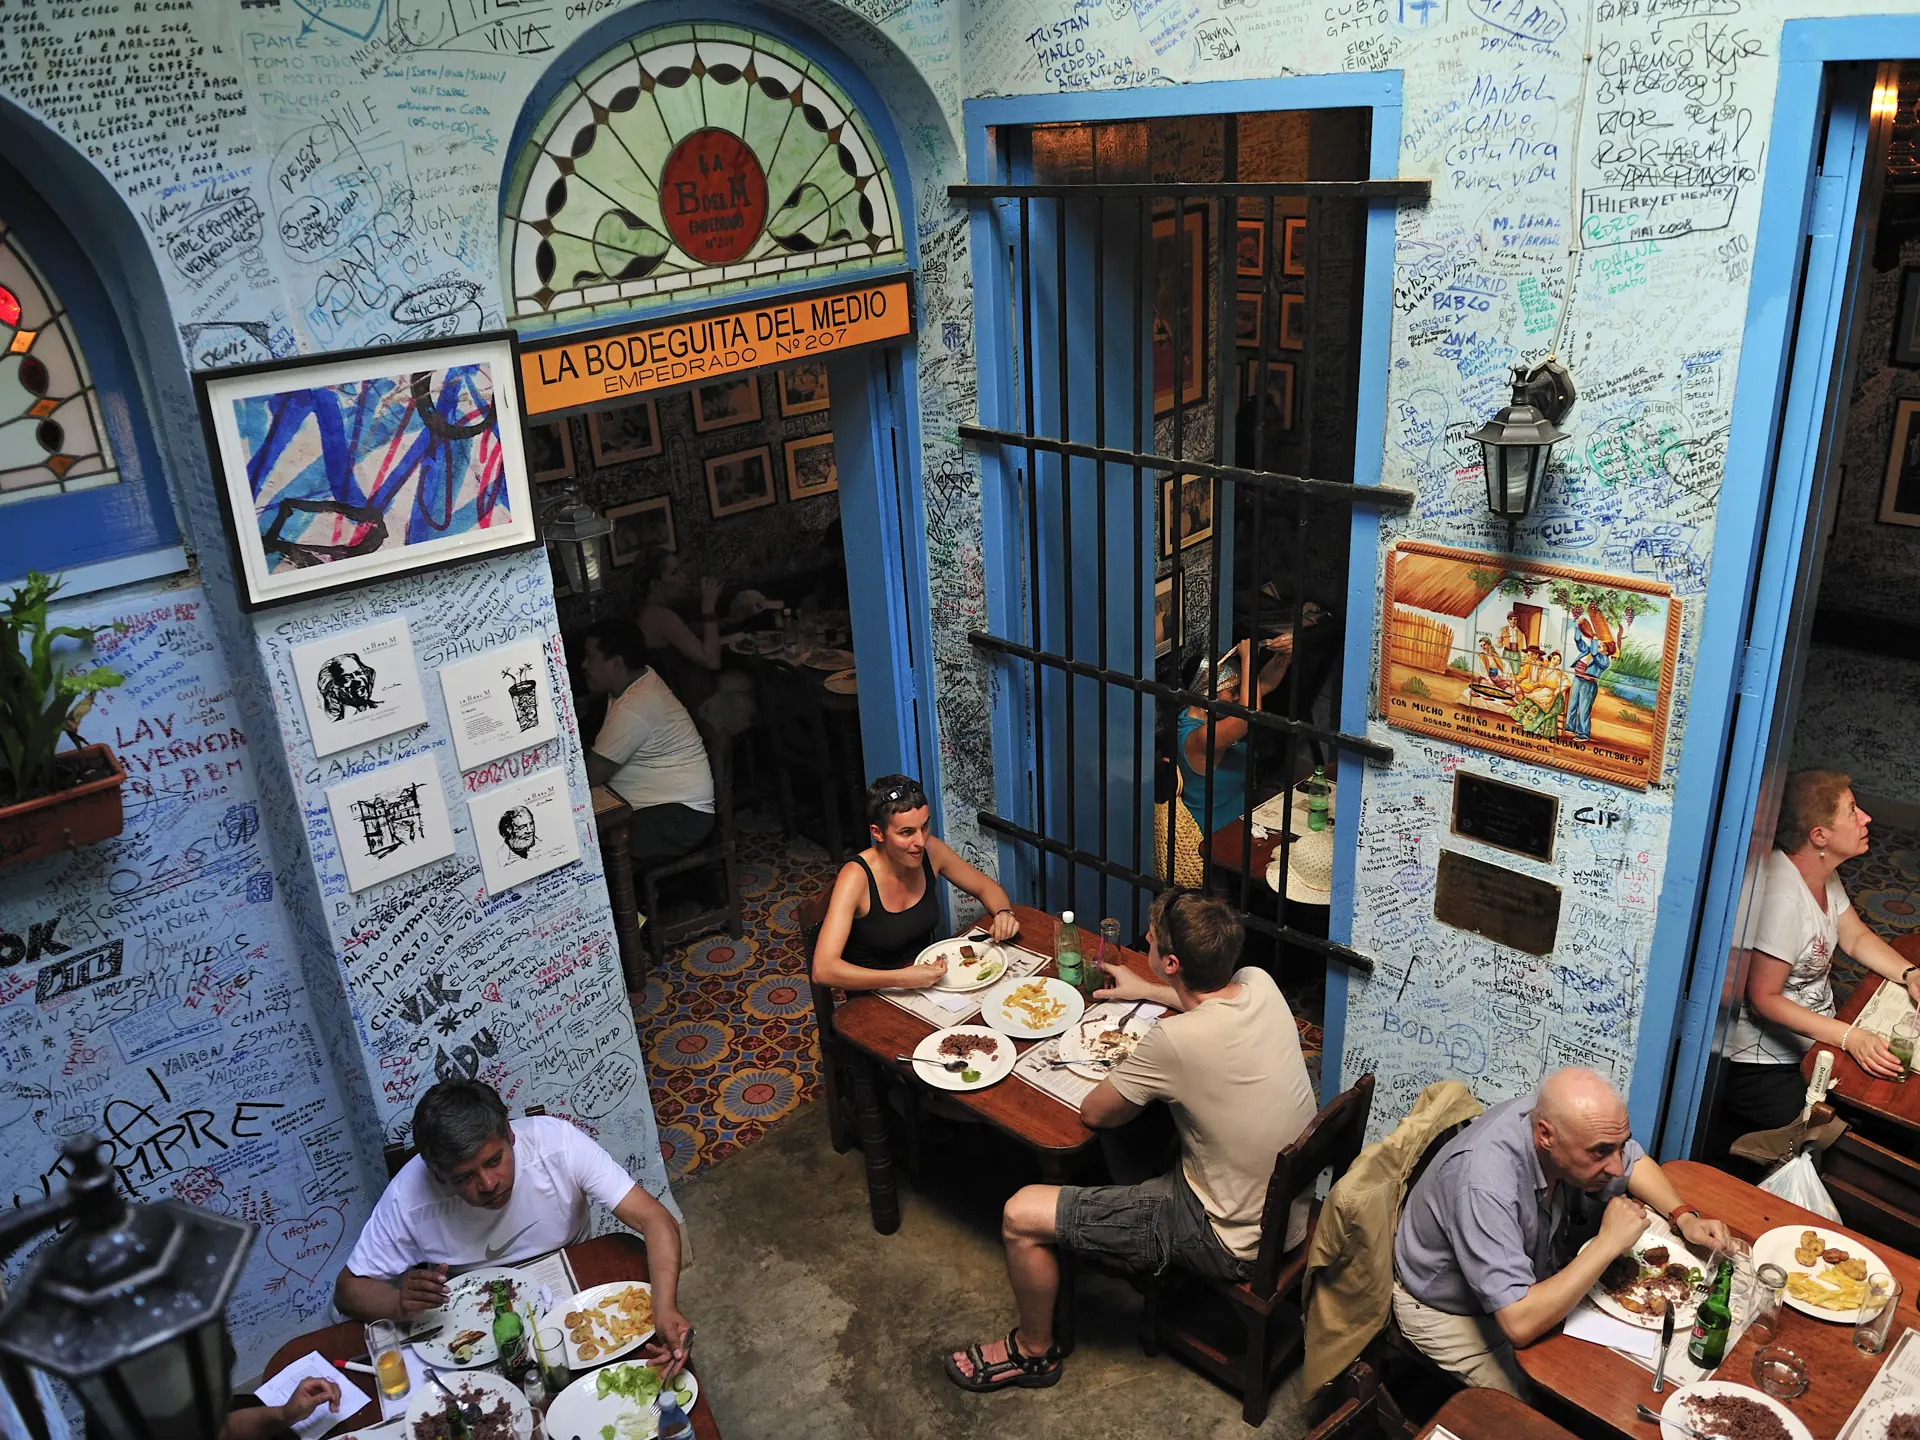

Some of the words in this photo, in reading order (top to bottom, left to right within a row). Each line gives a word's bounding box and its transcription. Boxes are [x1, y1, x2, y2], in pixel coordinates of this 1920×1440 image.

[52, 8, 75, 20] DEL
[82, 5, 120, 17] CIELO
[155, 1, 194, 12] CALAR
[1326, 10, 1389, 37] GATTO
[22, 35, 63, 49] BASSO
[126, 24, 150, 35] DEL
[44, 45, 83, 58] PESCE
[1037, 38, 1085, 68] MARCO
[115, 99, 137, 110] PER
[99, 114, 138, 127] LUNGO
[165, 116, 187, 128] CHE
[698, 153, 724, 175] LA
[128, 177, 162, 197] MARE
[1451, 273, 1507, 292] MADRID
[1432, 292, 1490, 312] PABLO
[1409, 315, 1452, 330] ENRIQUE
[538, 350, 580, 385] LA
[583, 318, 749, 376] BODEGUITA
[756, 307, 805, 341] DEL
[810, 290, 887, 330] MEDIO
[1442, 331, 1477, 347] ANA
[604, 347, 757, 394] EMPEDRADO
[805, 328, 849, 352] 207
[1687, 442, 1725, 465] FLOR
[1541, 519, 1585, 537] CULE
[1391, 698, 1407, 708] CON
[1412, 703, 1443, 716] MUCHO
[1454, 712, 1488, 726] CARIÑO
[1496, 723, 1507, 732] AL
[1511, 726, 1542, 741] PUEBLO
[1549, 736, 1586, 752] CUBANO
[1593, 747, 1630, 762] OCTUBRE
[1631, 756, 1644, 766] 95
[1423, 717, 1452, 728] DONADO
[181, 933, 250, 967] ALEXIS
[420, 934, 454, 977] CUBA
[1552, 1039, 1599, 1063] ISMAEL
[281, 1218, 328, 1241] THOMAS
[295, 1242, 331, 1260] LUPITA
